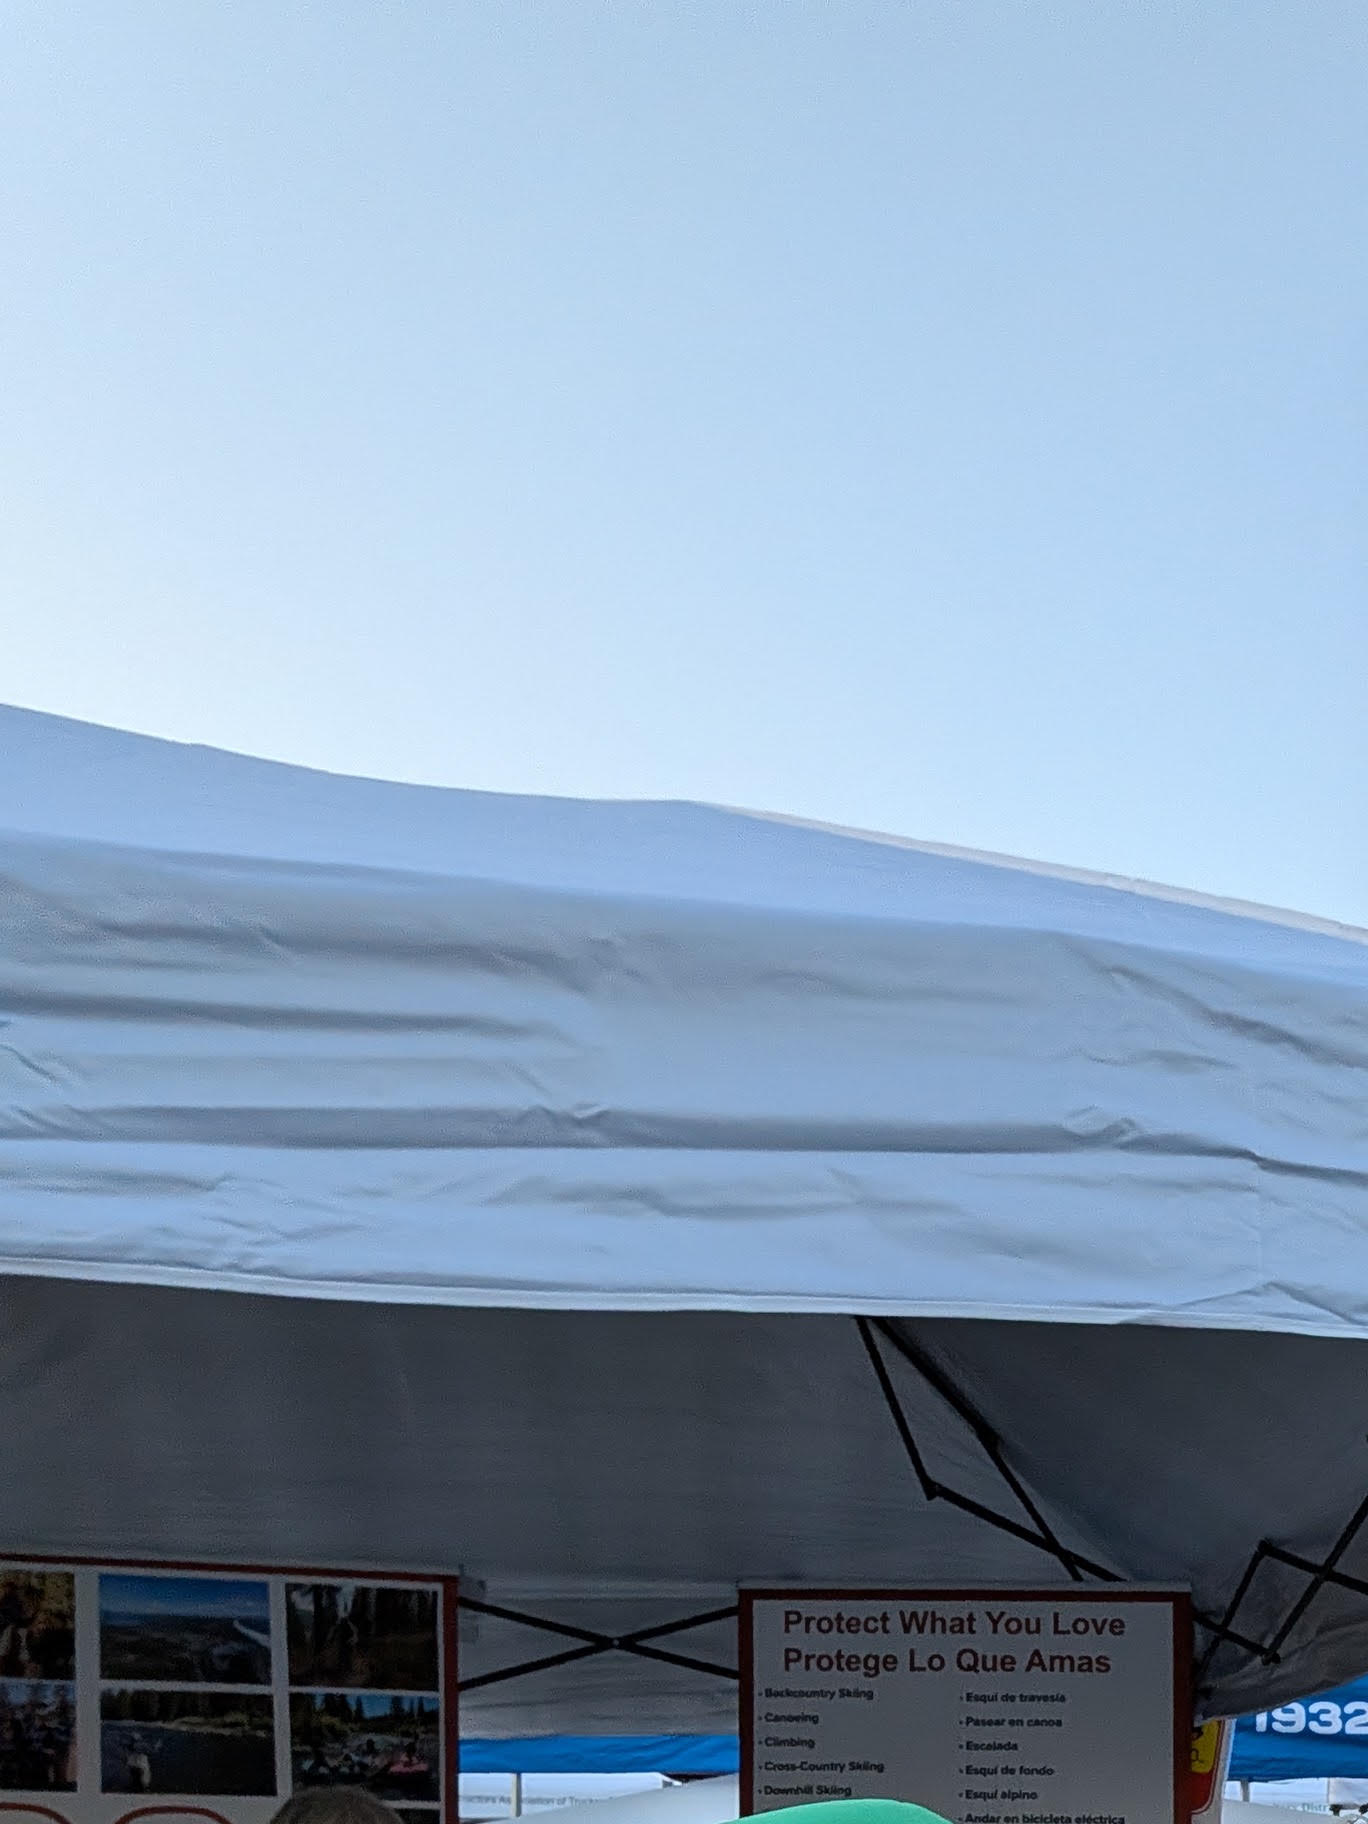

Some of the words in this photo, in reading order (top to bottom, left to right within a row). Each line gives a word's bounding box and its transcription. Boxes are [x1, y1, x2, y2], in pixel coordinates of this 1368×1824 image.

[784, 1610, 891, 1635] Protect
[899, 1610, 977, 1635] What
[985, 1611, 1042, 1636] You
[1053, 1612, 1126, 1636] Love
[784, 1648, 898, 1678] Protege
[909, 1648, 946, 1672] Lo
[956, 1648, 1017, 1674] Que
[1025, 1649, 1111, 1673] Amas
[764, 1688, 836, 1700] Backcountry
[838, 1688, 874, 1700] Skiing
[966, 1692, 998, 1703] Esquí
[1001, 1693, 1016, 1703] de
[764, 1712, 819, 1725] Canoeing
[966, 1717, 1005, 1727] Pasear
[1009, 1718, 1024, 1727] en
[1027, 1718, 1063, 1727] canoa
[764, 1737, 816, 1750] Climbing
[966, 1741, 1018, 1751] Escalada
[764, 1761, 846, 1773] Cross-Country
[848, 1761, 884, 1773] Skiing
[966, 1765, 998, 1776] Esquí
[1001, 1766, 1016, 1775] de
[1019, 1765, 1055, 1775] fondo
[764, 1785, 813, 1796] Downhill
[816, 1785, 852, 1797] Skiing
[966, 1789, 998, 1801] Esquí
[1001, 1790, 1038, 1801] alpino
[965, 1814, 1001, 1824] Andar
[1004, 1815, 1019, 1824] en
[1022, 1814, 1072, 1824] bicicleta
[1075, 1814, 1125, 1824] eléctrica
